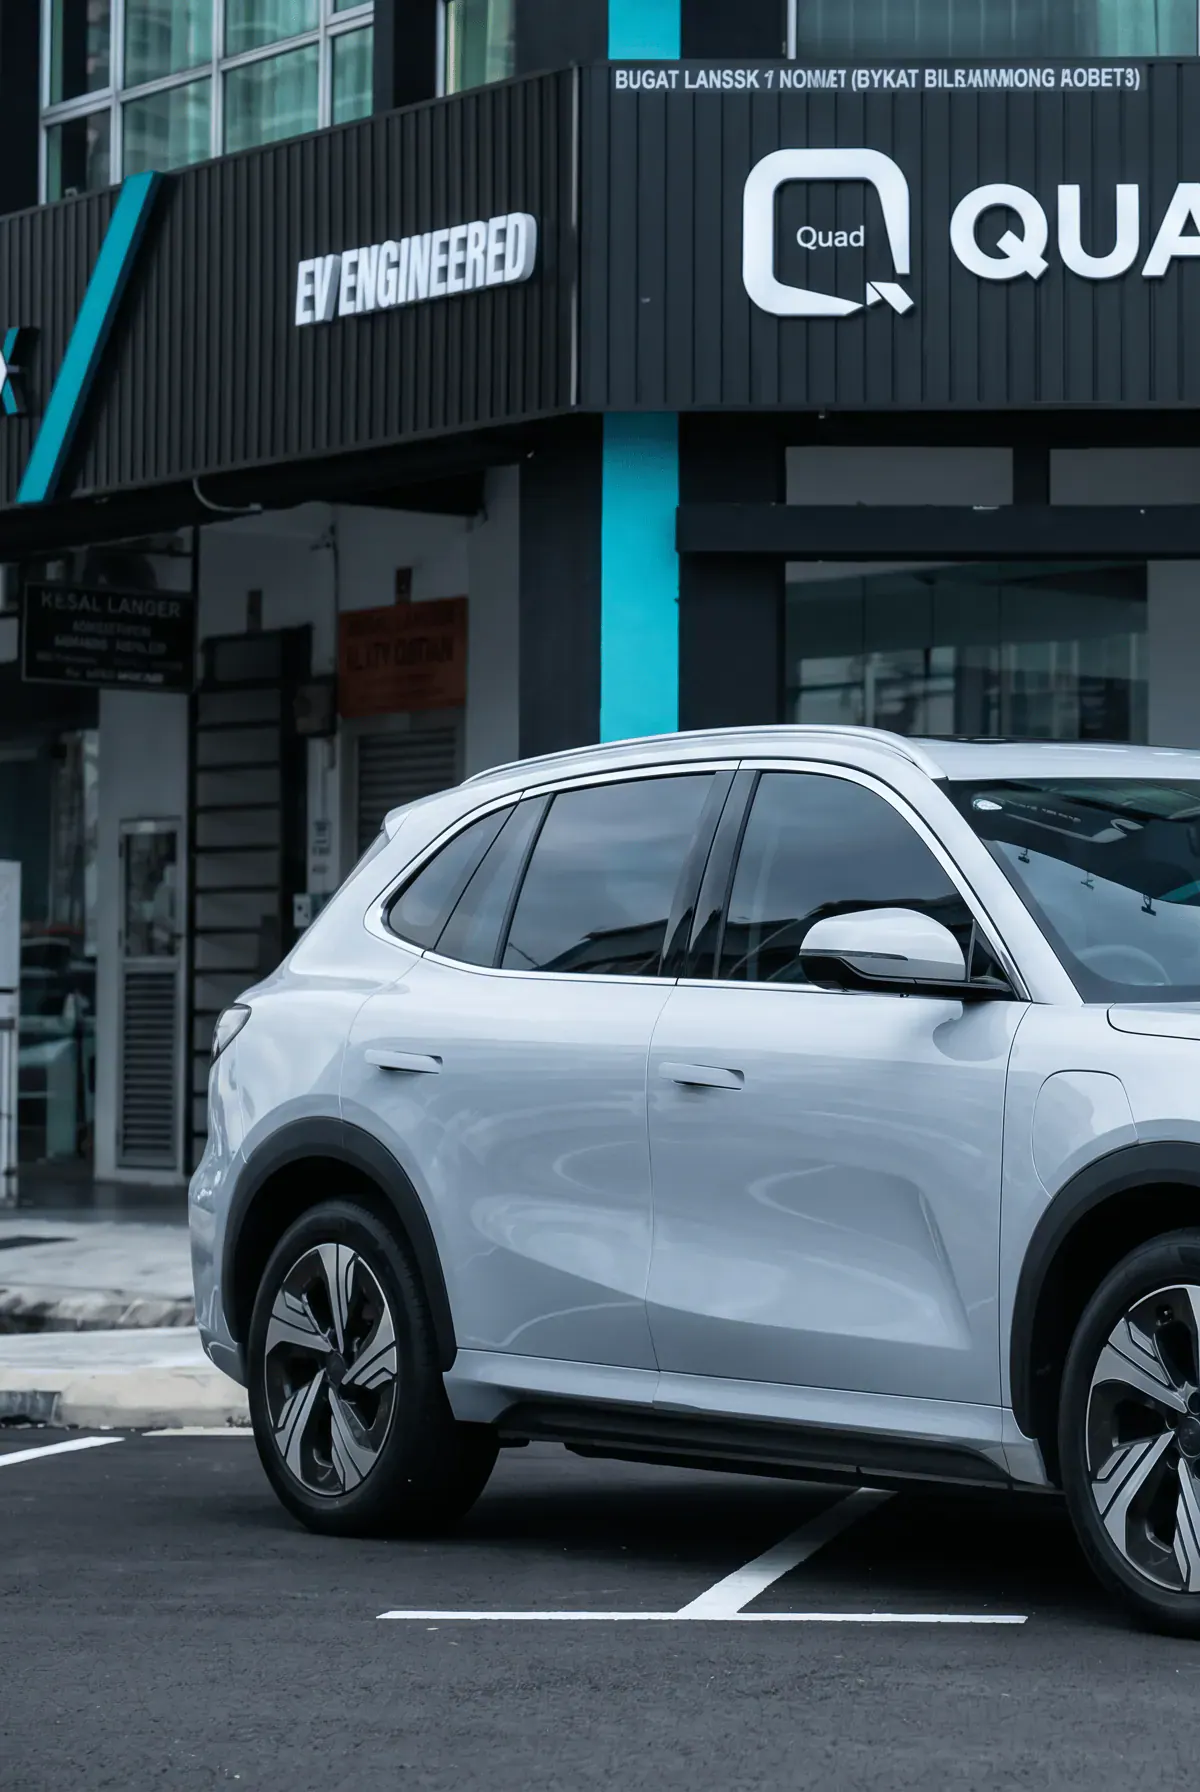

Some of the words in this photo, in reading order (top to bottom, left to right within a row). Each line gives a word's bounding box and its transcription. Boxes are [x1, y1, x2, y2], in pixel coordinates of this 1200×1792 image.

[615, 68, 680, 90] BUGAT
[684, 68, 761, 90] LANSSK
[796, 224, 865, 250] Quad
[295, 254, 341, 326] EV
[339, 211, 537, 317] ENGINEERED
